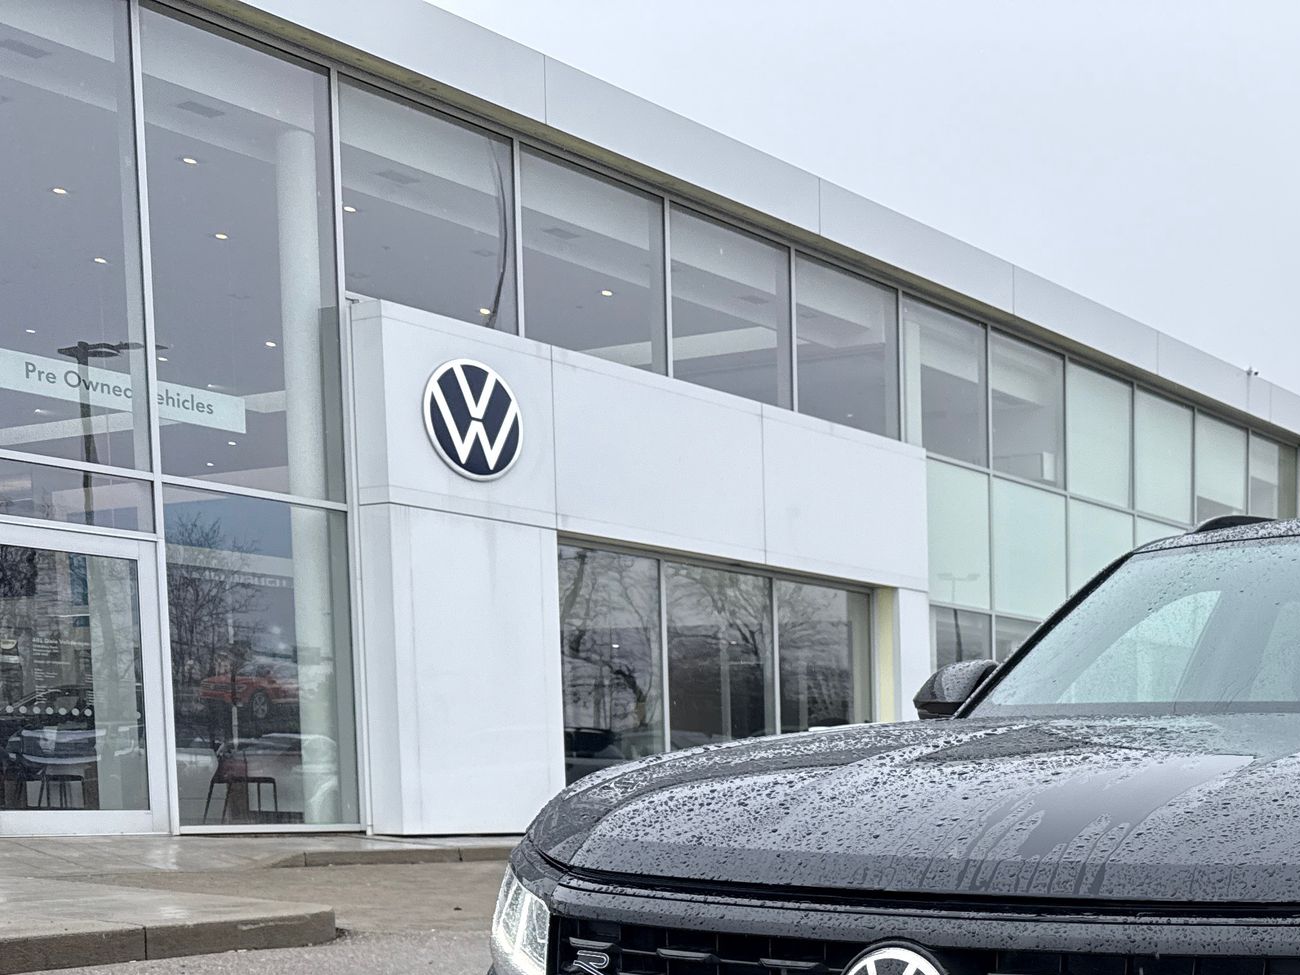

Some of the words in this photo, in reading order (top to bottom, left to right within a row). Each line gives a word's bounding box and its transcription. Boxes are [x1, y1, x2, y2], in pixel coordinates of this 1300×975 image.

[24, 361, 57, 384] Pre
[156, 389, 214, 415] ehicles
[425, 361, 521, 477] VW
